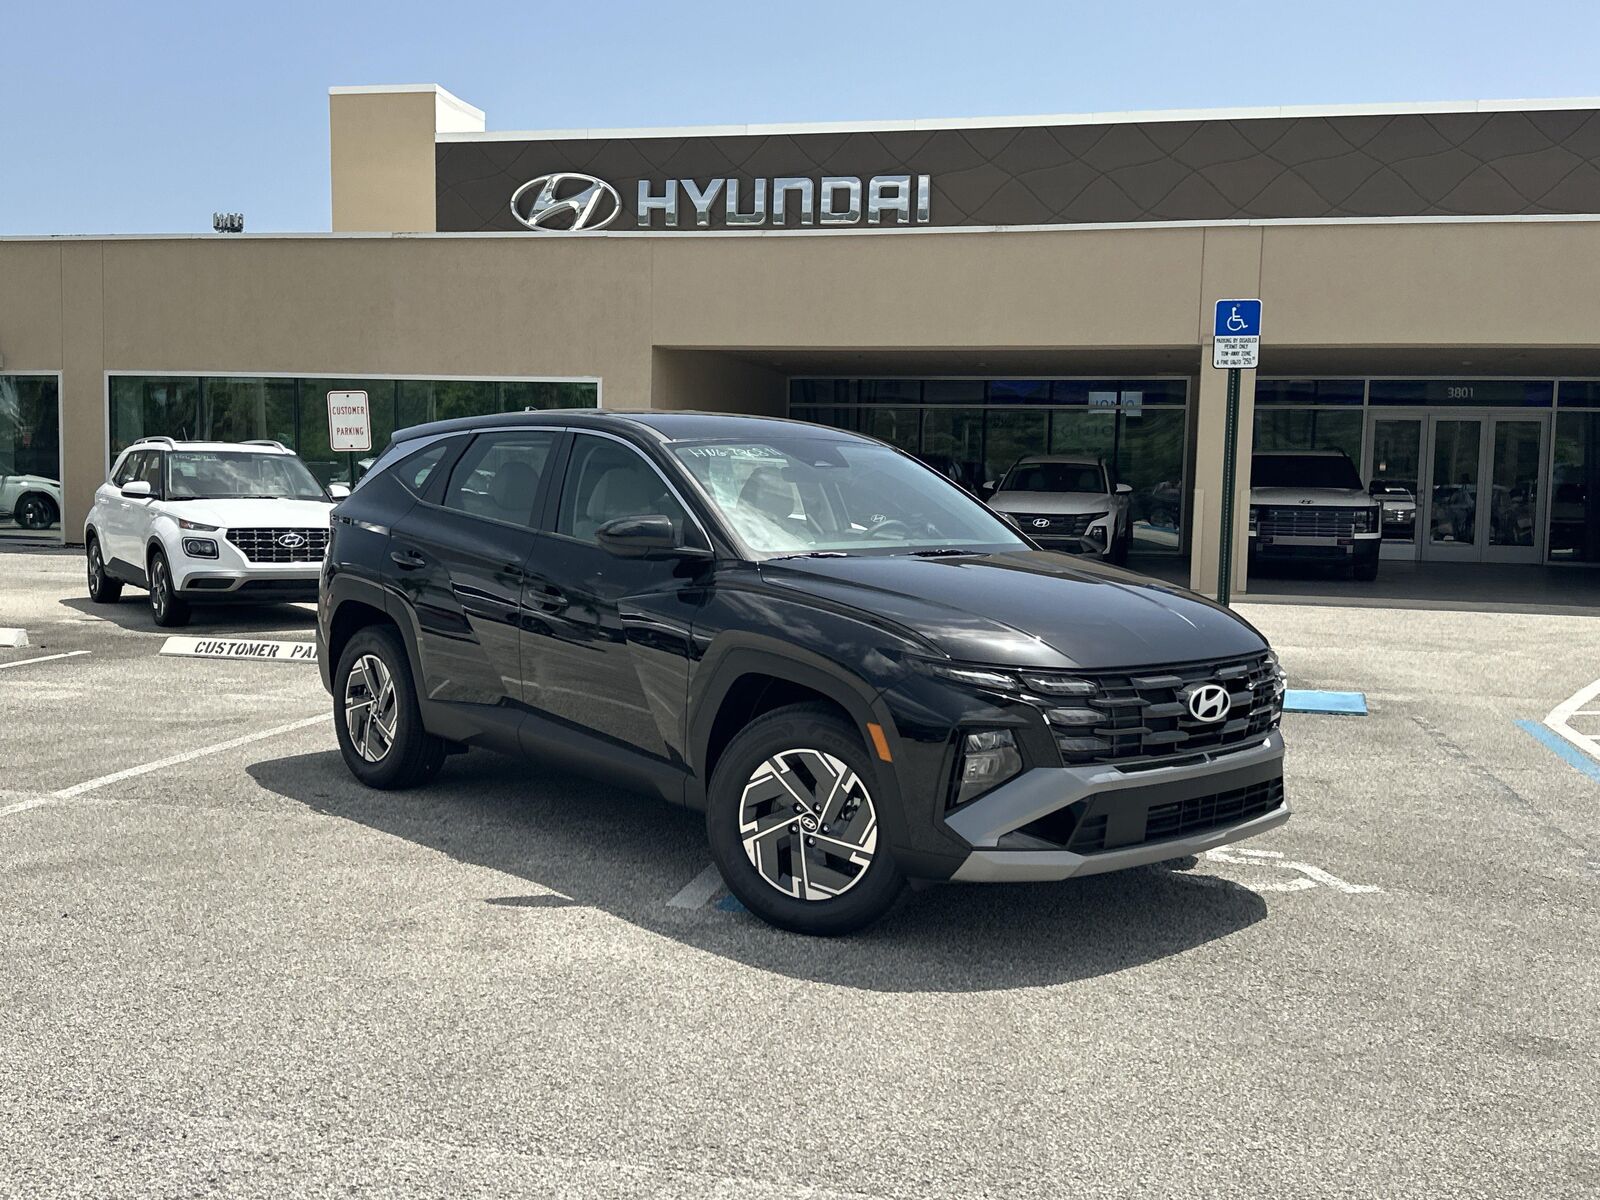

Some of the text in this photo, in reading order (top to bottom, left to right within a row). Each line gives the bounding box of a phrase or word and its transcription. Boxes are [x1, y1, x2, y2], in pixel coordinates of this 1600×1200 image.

[637, 174, 931, 228] HYUNDAI
[1447, 386, 1474, 398] 3801
[332, 406, 365, 415] CUSTOMER
[336, 427, 364, 436] PARKING
[194, 641, 280, 658] CUSTOMER
